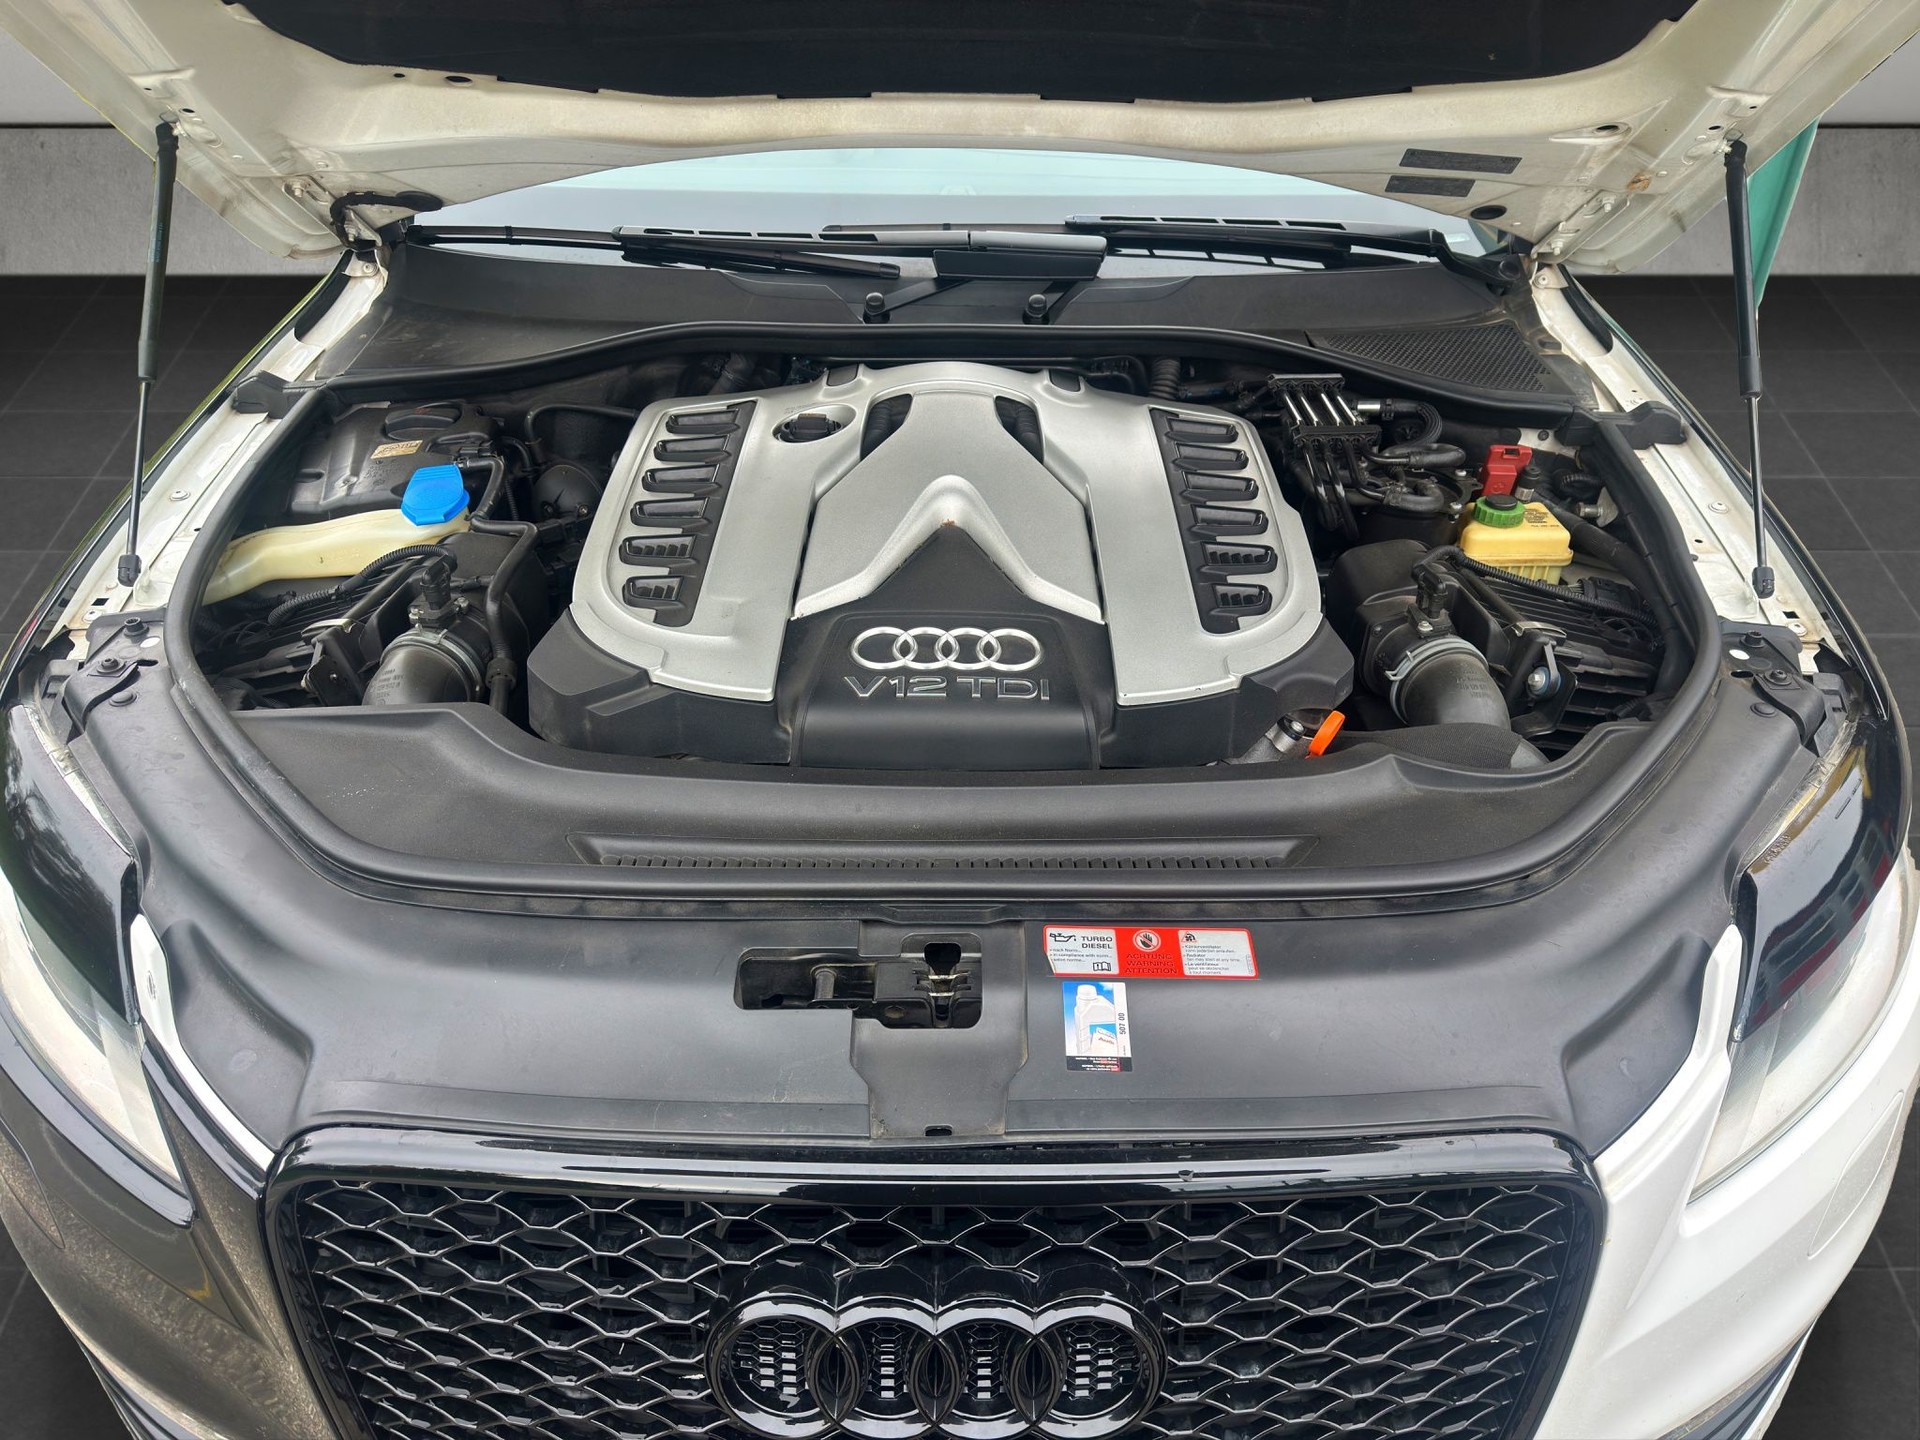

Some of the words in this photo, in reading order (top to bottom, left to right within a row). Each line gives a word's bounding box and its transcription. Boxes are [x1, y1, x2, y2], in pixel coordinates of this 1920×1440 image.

[844, 676, 947, 698] V12
[956, 676, 1050, 700] TDI
[1118, 1012, 1125, 1021] 00
